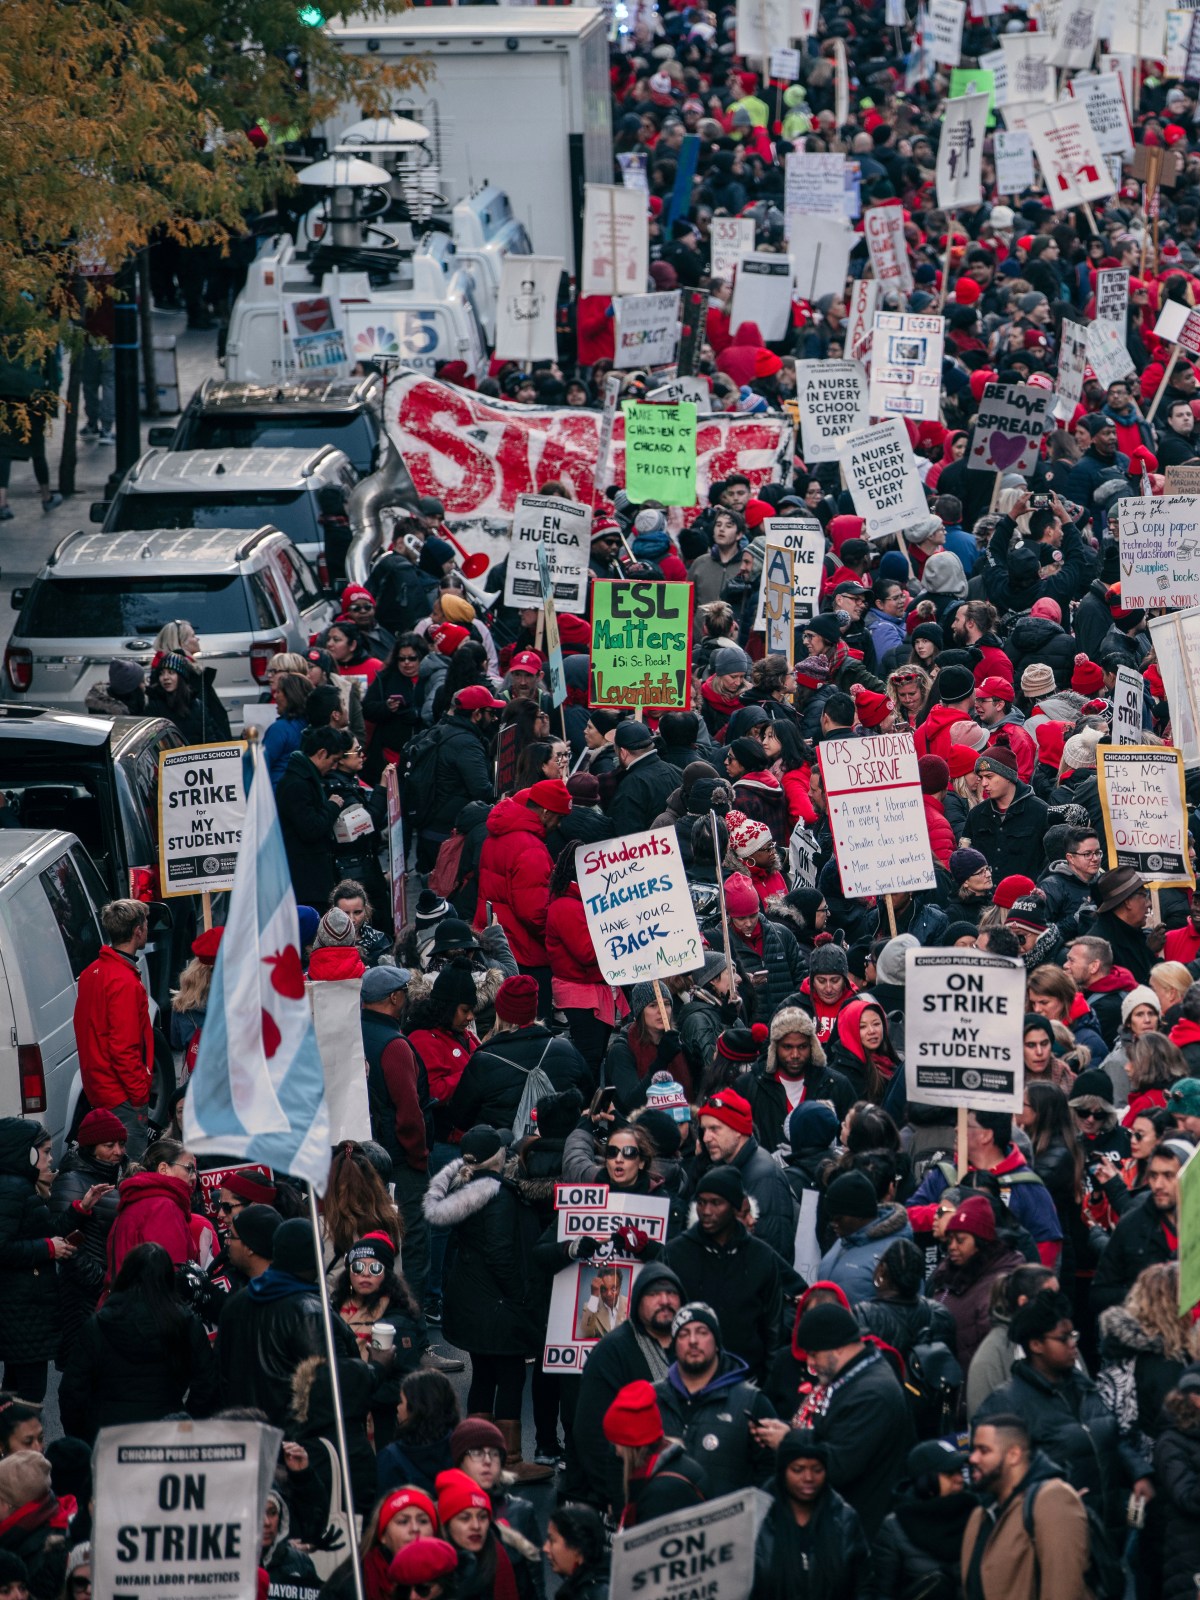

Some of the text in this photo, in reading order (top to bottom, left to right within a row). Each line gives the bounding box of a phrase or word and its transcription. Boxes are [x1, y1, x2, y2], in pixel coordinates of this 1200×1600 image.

[807, 379, 860, 389] A NURSE
[807, 391, 861, 402] IN EVERY
[984, 384, 1047, 416] BE LOVE
[658, 408, 680, 420] THE
[809, 402, 860, 414] SCHOOL
[817, 414, 855, 425] EVERY
[977, 413, 1045, 437] SPREAD
[822, 426, 851, 438] DAY!
[633, 441, 687, 453] CHICAGO A
[851, 455, 860, 466] A
[861, 441, 903, 462] NURSE
[637, 463, 691, 478] PRIORITY
[854, 453, 905, 478] IN EVERY
[858, 467, 908, 489] SCHOOL
[868, 480, 905, 500] EVERY
[877, 493, 905, 510] DAY!
[542, 516, 561, 531] EN
[1142, 522, 1199, 537] copy paper
[519, 528, 580, 548] HUELGA
[783, 536, 803, 548] ON
[1122, 540, 1177, 554] technology for
[1121, 549, 1176, 563] my classroom
[1135, 563, 1169, 575] supplies
[1173, 569, 1200, 582] books
[611, 582, 680, 619] ESL
[1125, 595, 1200, 608] FUND OUR SCHOOLS
[593, 619, 686, 651] Matters
[826, 733, 917, 765] CPS STUDENTS
[166, 750, 238, 766] CHICAGO PUBLIC SCHOOLS
[1151, 755, 1177, 763] SCHOOLS
[184, 768, 214, 787] ON
[848, 758, 903, 787] DESERVE
[1110, 780, 1162, 793] About The
[169, 784, 238, 809] STRIKE
[1112, 794, 1168, 807] INCOME
[847, 812, 905, 830] in every school
[1110, 808, 1169, 820] It's About
[191, 818, 215, 834] MY
[1134, 820, 1150, 829] The
[168, 829, 242, 851] STUDENTS
[849, 833, 919, 852] Smaller class sizes
[584, 834, 675, 876] Students,
[852, 852, 926, 872] More social workers
[586, 874, 674, 916] TEACHERS
[917, 957, 952, 966] CHICAGO
[953, 957, 979, 966] PUBLIC
[632, 962, 652, 979] your
[946, 973, 984, 993] ON
[923, 993, 1008, 1015] STRIKE
[952, 1027, 980, 1042] MY
[919, 1042, 1011, 1061] STUDENTS
[558, 1188, 604, 1205] LORI
[547, 1348, 576, 1364] DO
[121, 1445, 243, 1461] CHICAGO PUBLIC SCHOOLS
[158, 1474, 206, 1511] ON
[117, 1523, 242, 1563] STRIKE
[659, 1531, 706, 1559] ON
[631, 1541, 735, 1592] STRIKE
[116, 1572, 241, 1587] UNFAIR LABOR PRACTICES
